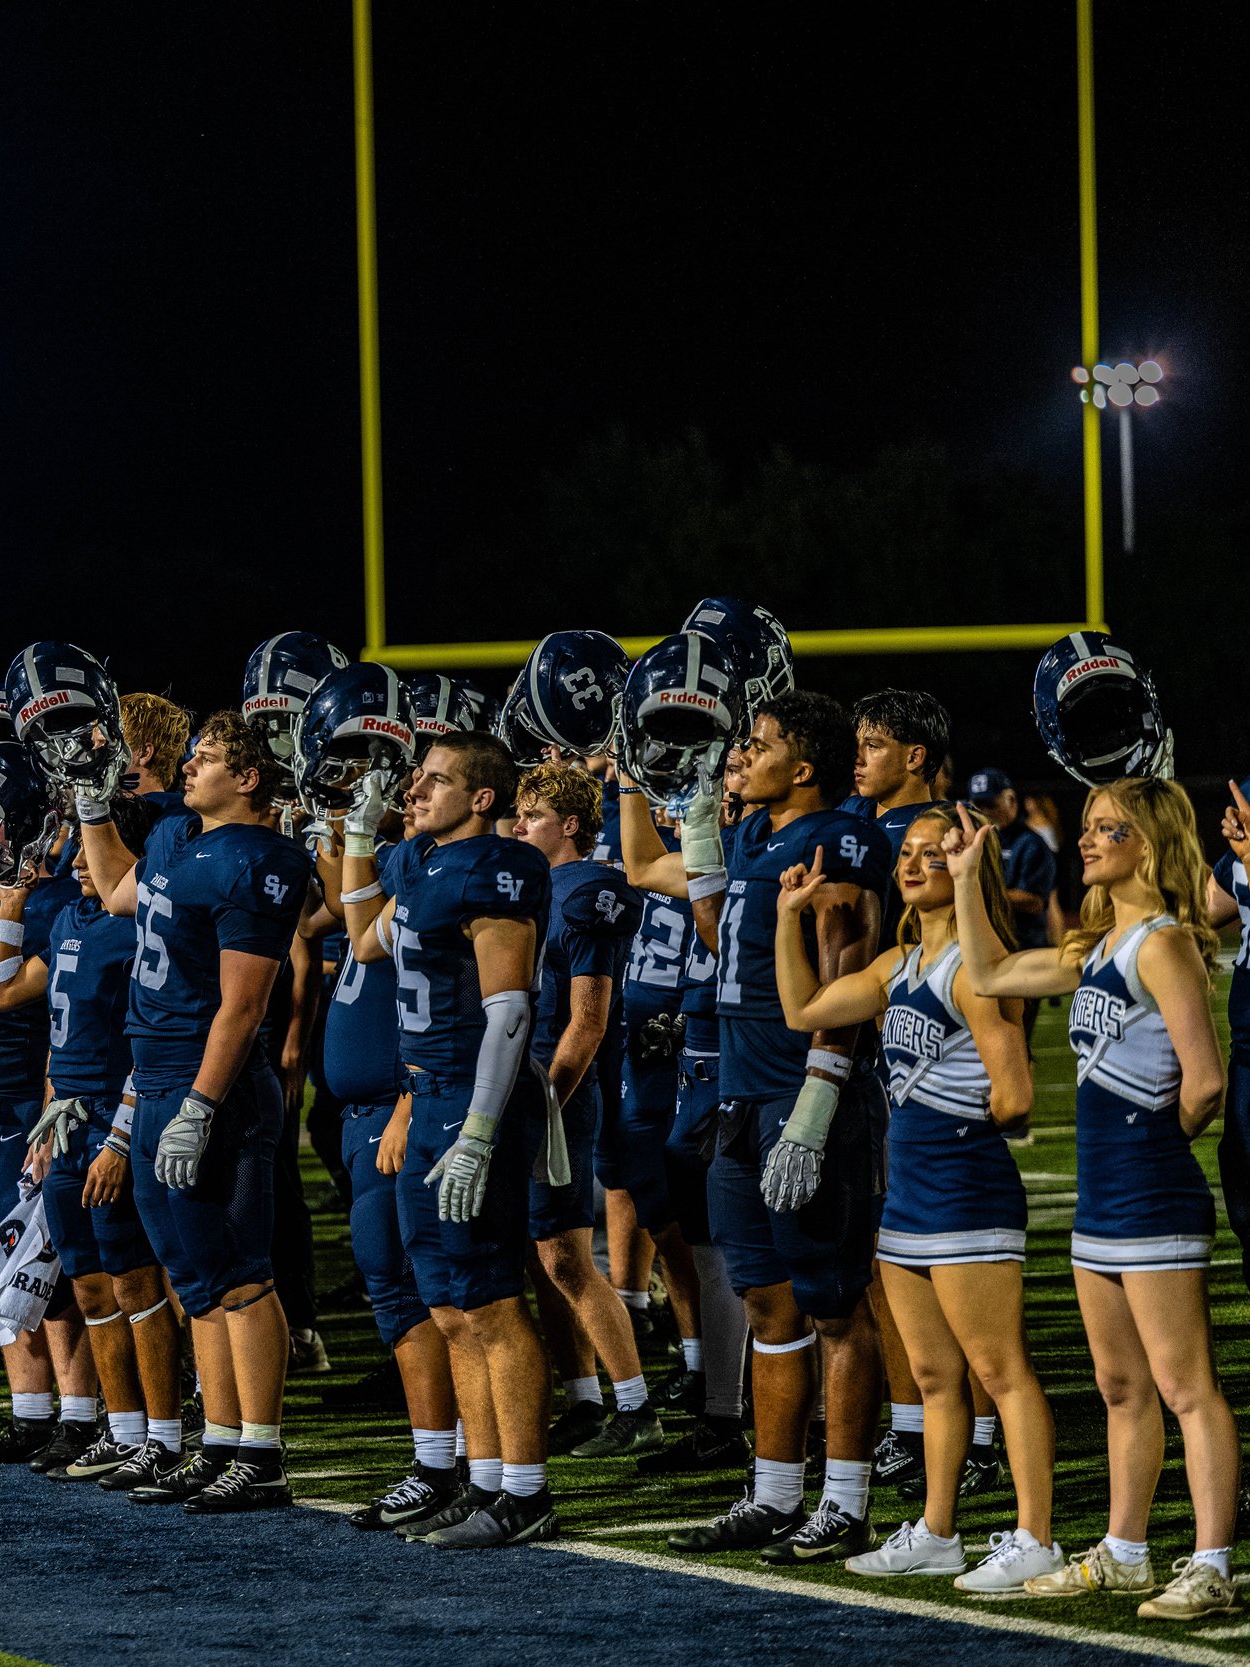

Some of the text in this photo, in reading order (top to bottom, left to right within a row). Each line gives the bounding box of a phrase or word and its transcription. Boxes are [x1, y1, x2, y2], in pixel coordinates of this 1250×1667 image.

[1066, 658, 1120, 683] Riddell
[564, 667, 603, 711] 33
[660, 692, 718, 710] Riddell
[20, 691, 70, 723] Riddell
[245, 697, 289, 714] Riddell
[362, 717, 412, 745] Riddell
[840, 834, 869, 868] SV
[263, 874, 289, 904] SV
[496, 871, 524, 901] SV
[50, 953, 78, 1048] 5
